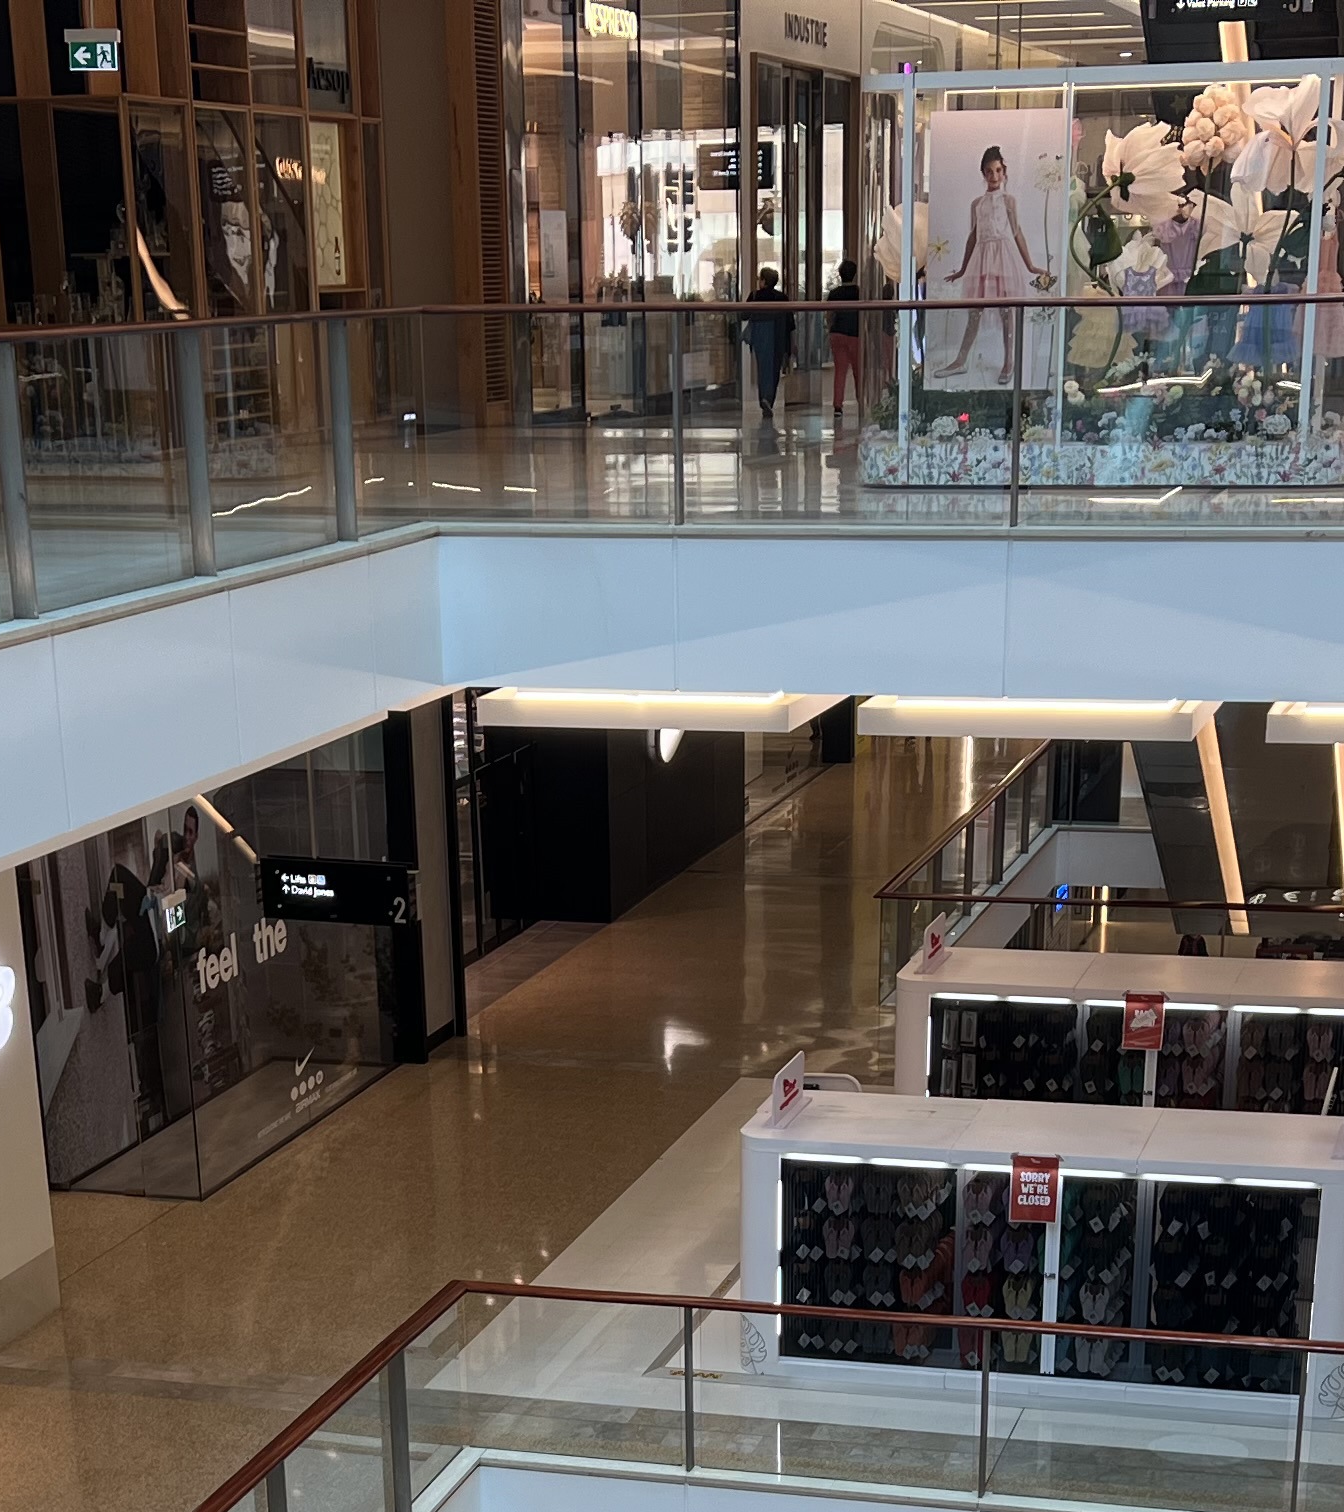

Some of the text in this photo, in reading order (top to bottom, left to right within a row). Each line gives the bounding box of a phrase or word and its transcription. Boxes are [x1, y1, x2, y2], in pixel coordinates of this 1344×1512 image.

[584, 0, 637, 40] NESPRESSO
[784, 12, 828, 47] INDUSTRIE
[291, 885, 335, 898] David Jones
[393, 896, 406, 924] 2
[197, 917, 287, 994] feel the
[1019, 1171, 1051, 1184] SORRY
[1020, 1183, 1049, 1195] WE'RE
[1017, 1194, 1051, 1206] CLOSED
